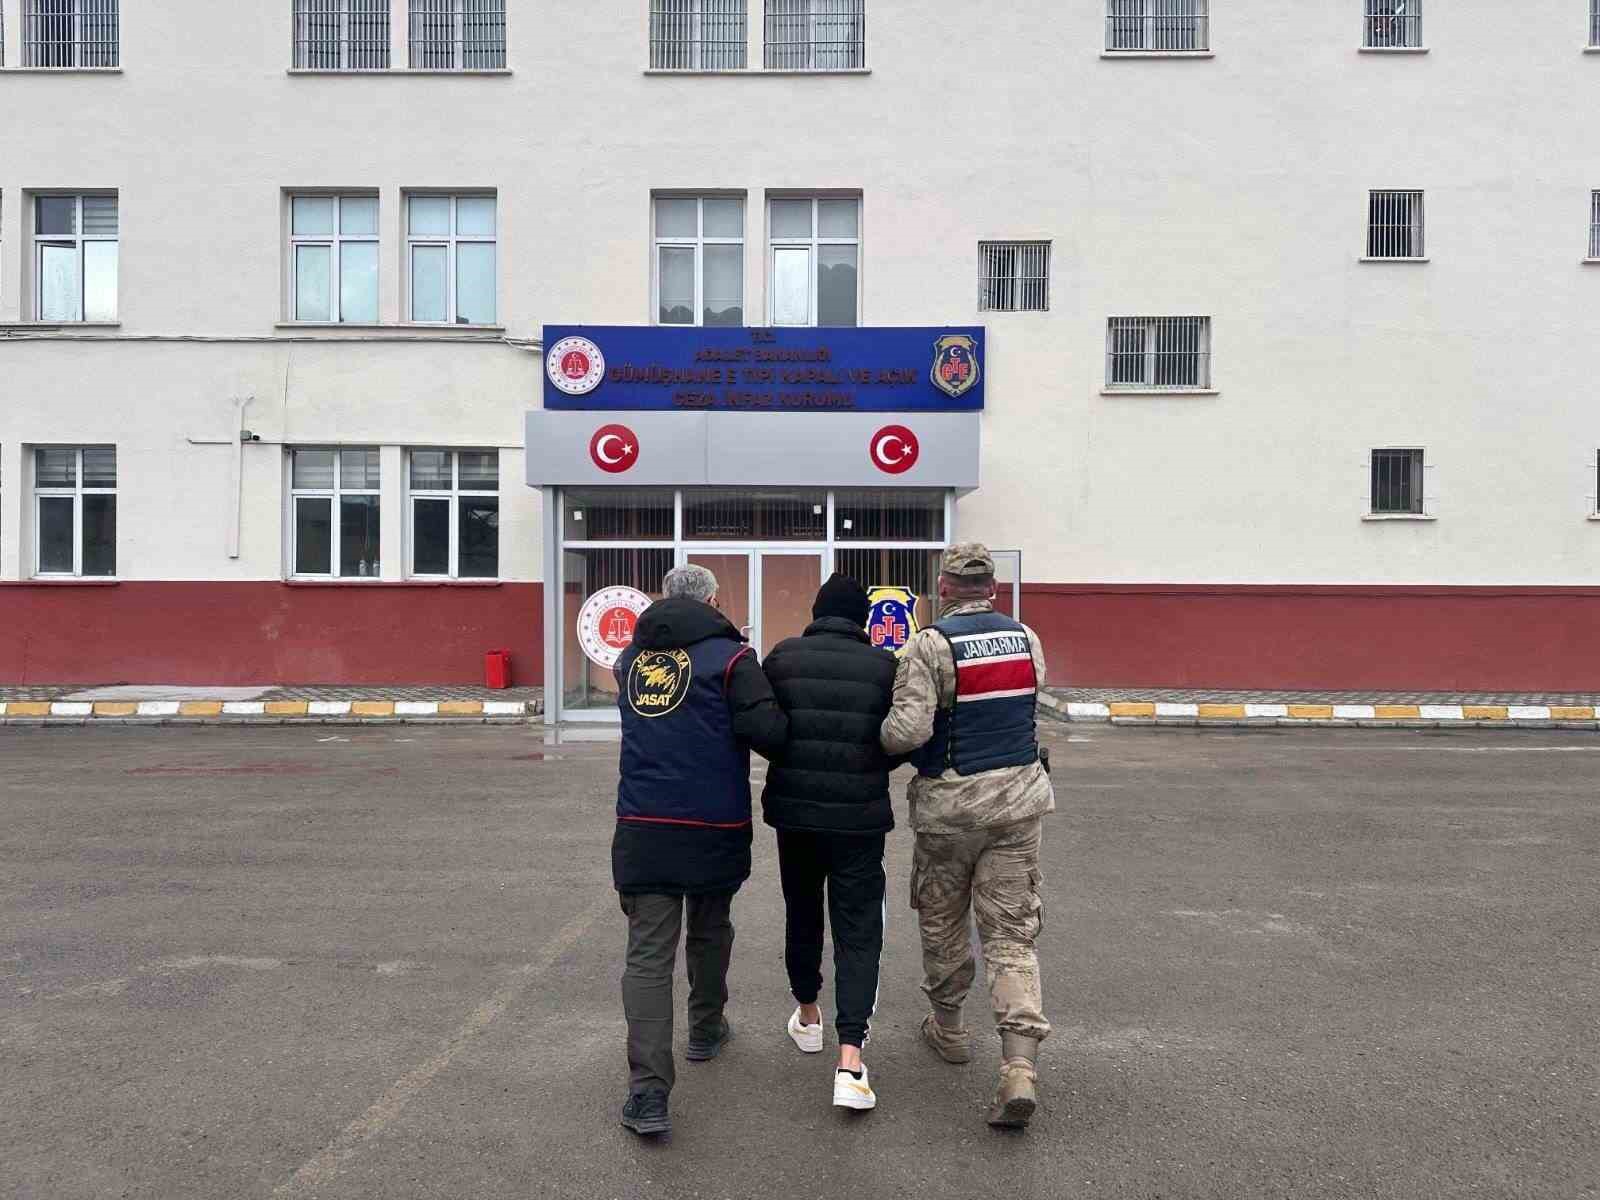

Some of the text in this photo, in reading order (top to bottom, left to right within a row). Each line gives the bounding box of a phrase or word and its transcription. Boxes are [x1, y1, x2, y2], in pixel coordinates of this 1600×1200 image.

[726, 367, 737, 384] E
[848, 367, 872, 384] VE
[672, 391, 717, 408] CEZA
[780, 391, 854, 408] KURUMU
[871, 616, 906, 645] CTE
[963, 636, 1027, 659] JANDARMA
[636, 693, 672, 706] JASAT
